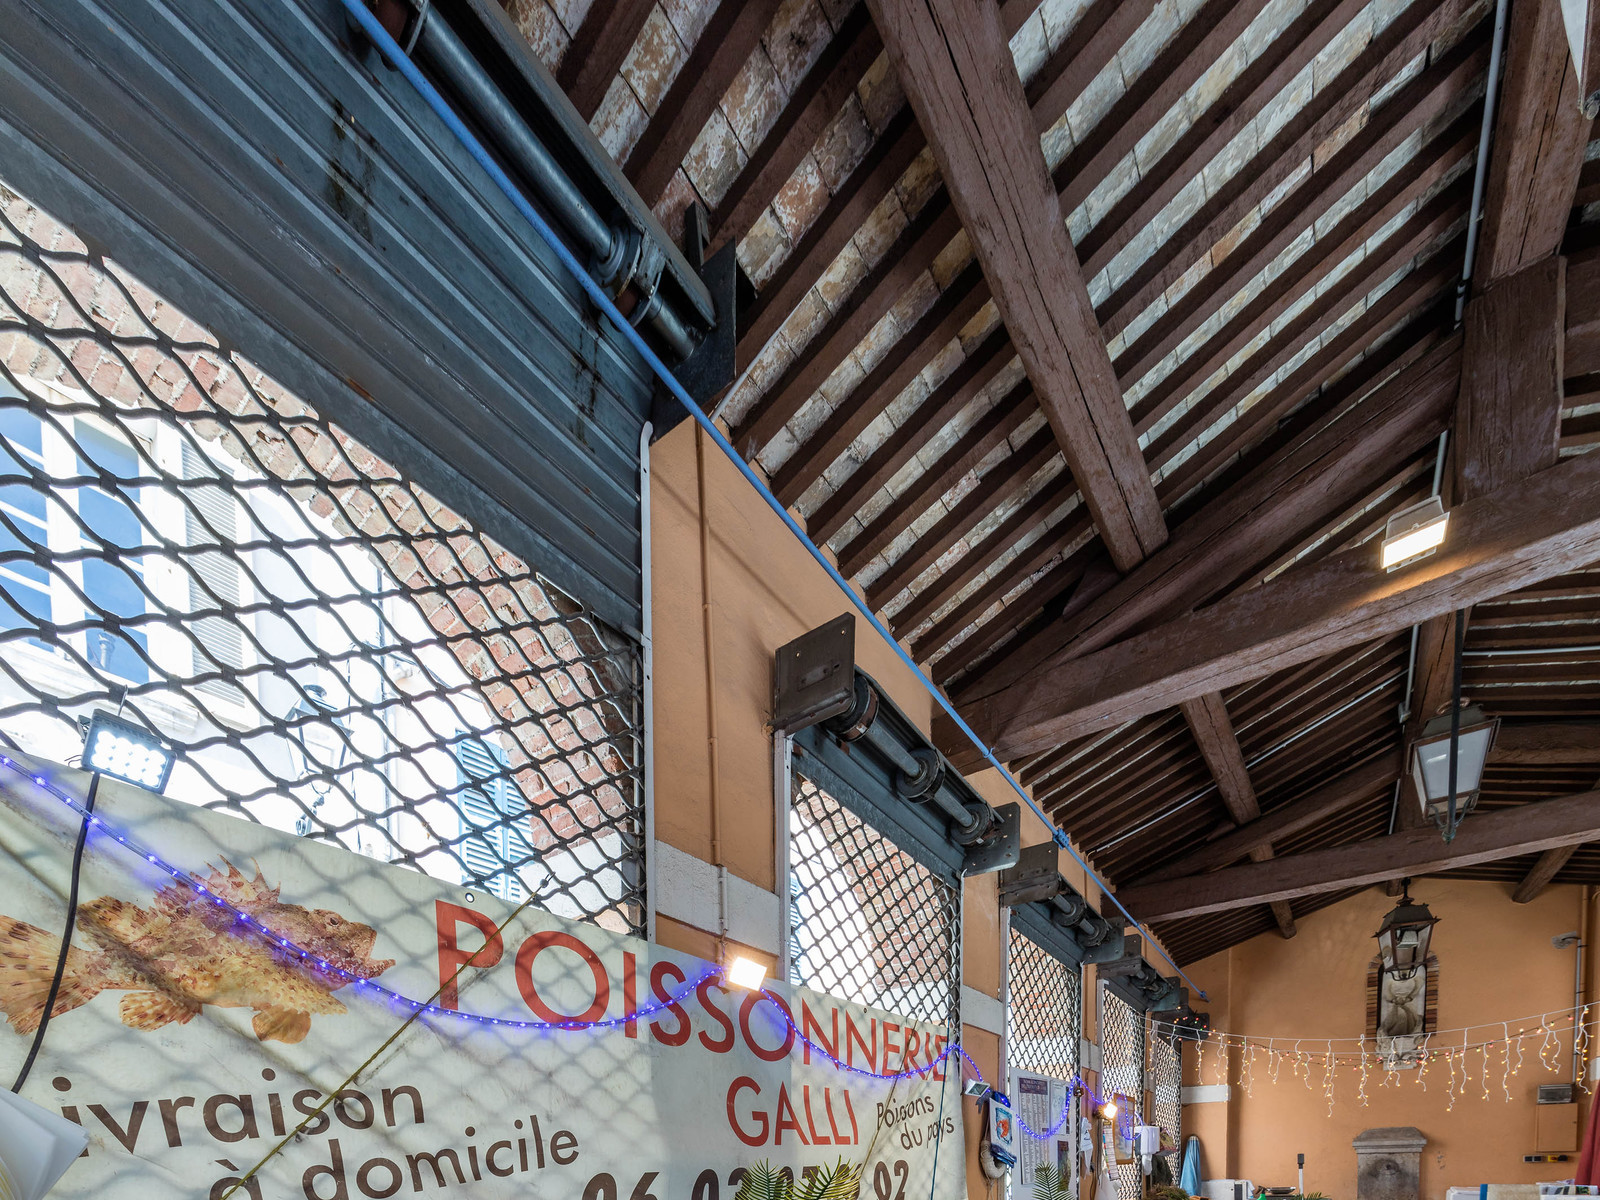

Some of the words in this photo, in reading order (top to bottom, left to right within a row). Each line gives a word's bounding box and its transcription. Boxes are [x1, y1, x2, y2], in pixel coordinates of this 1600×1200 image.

[435, 899, 949, 1082] POISSONNERIE
[52, 1067, 425, 1158] ivraison
[726, 1075, 858, 1147] GALLI
[900, 1122, 923, 1150] du
